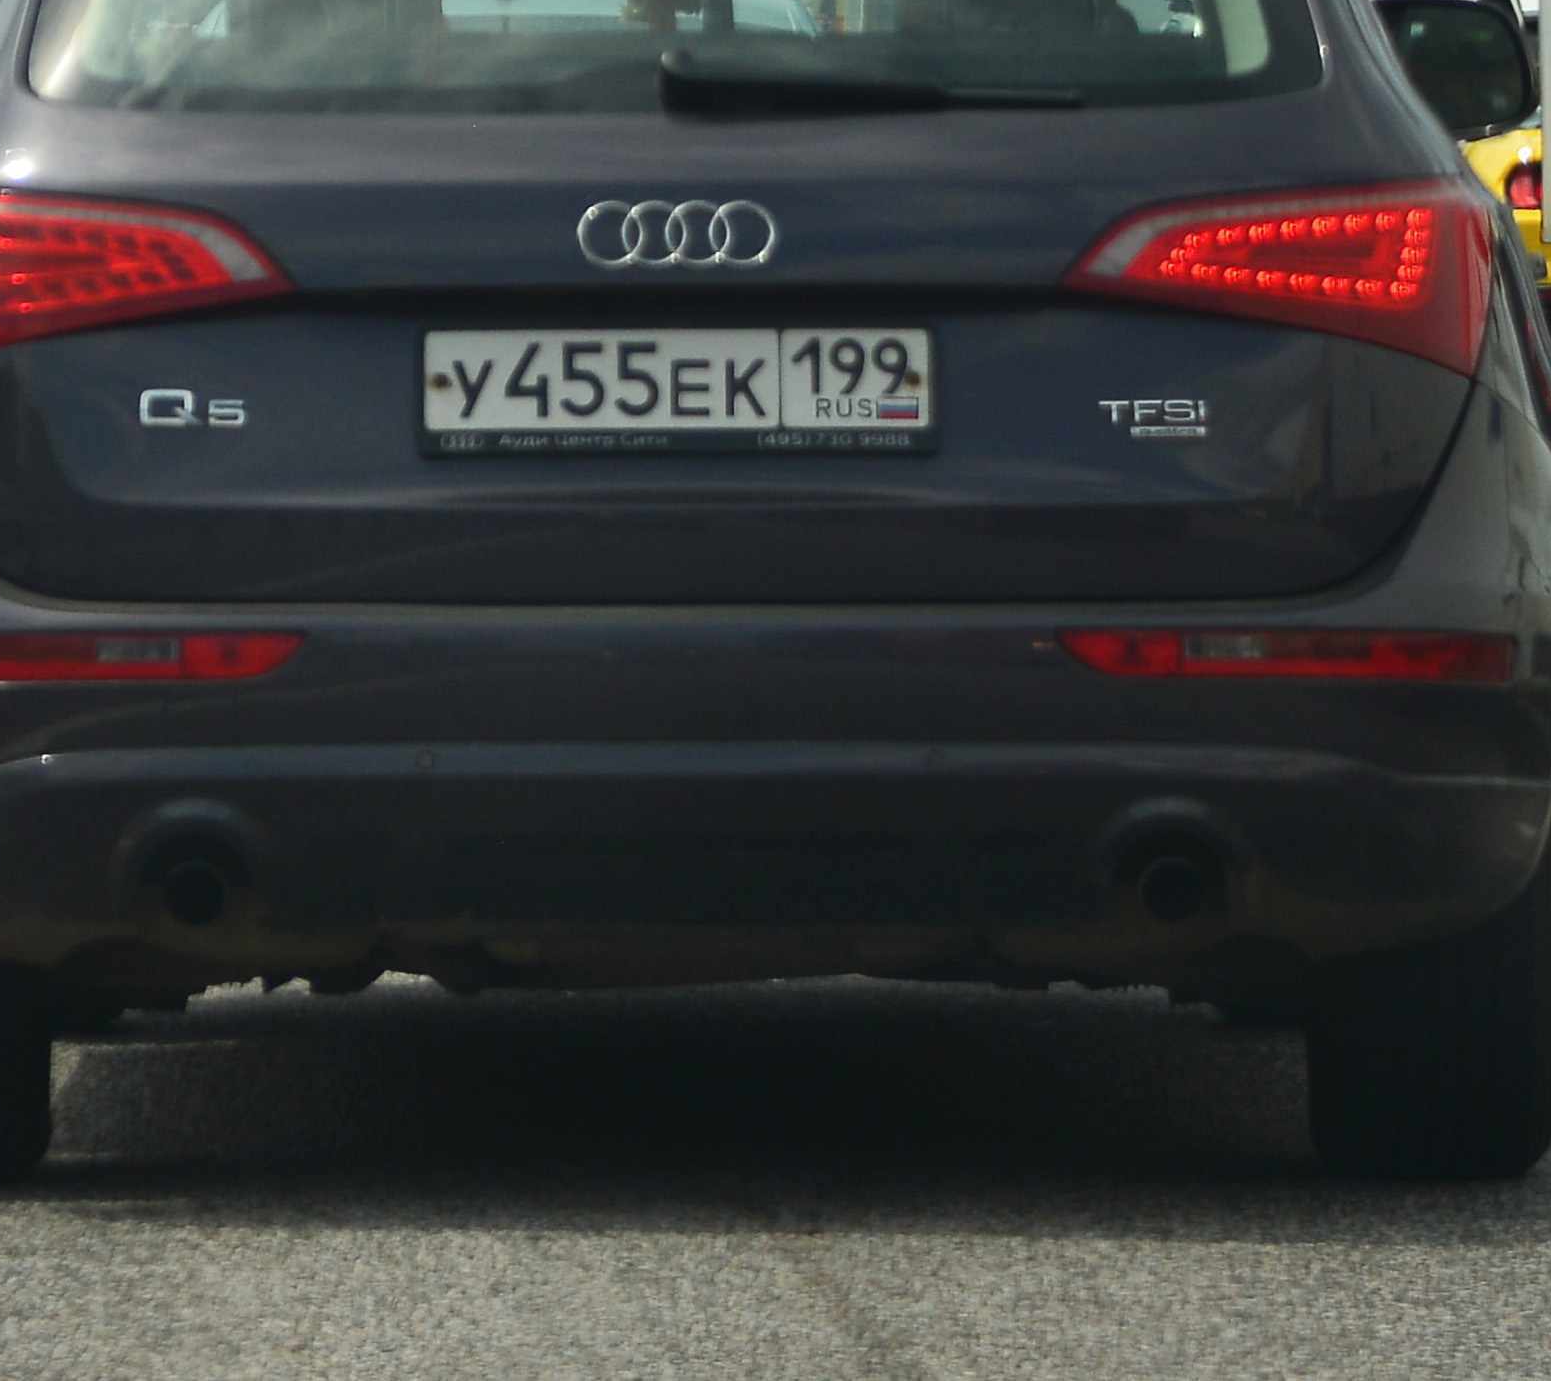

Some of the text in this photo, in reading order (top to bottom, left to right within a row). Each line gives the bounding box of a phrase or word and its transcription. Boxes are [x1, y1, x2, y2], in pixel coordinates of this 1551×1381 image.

[791, 337, 910, 395] 199
[139, 388, 245, 427] Q5
[815, 397, 873, 418] RUS
